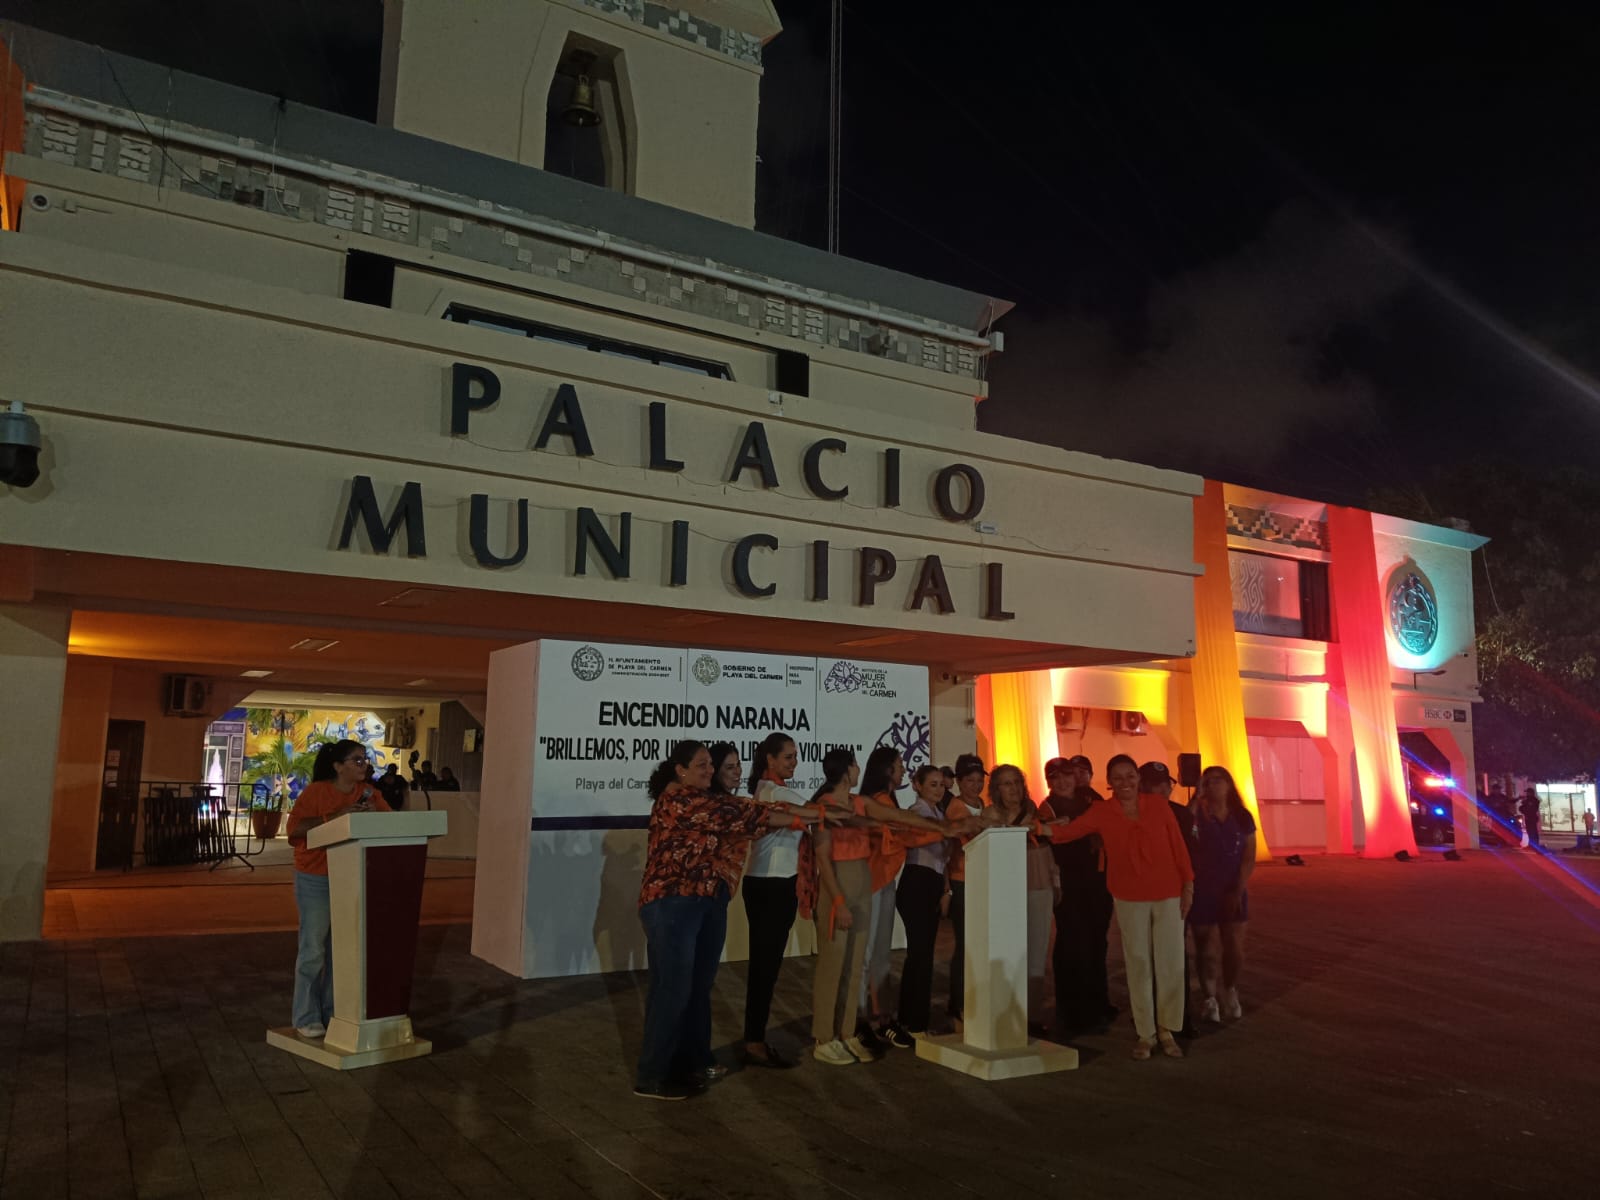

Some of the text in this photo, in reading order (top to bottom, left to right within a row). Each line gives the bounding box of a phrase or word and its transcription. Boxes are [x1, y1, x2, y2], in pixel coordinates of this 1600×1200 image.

[450, 362, 986, 522] PALACIO
[338, 474, 1016, 620] MUNICIPAL
[615, 657, 661, 665] AYUNTAMIENTO
[722, 665, 756, 673] GOBIERNO
[862, 673, 886, 681] MUJER
[862, 680, 887, 689] PLAYA
[869, 690, 897, 698] CARMEN
[599, 701, 810, 732] ENCENDIDO NARANJA
[539, 736, 629, 762] "BRILLEMOS,
[633, 739, 660, 761] POR
[575, 777, 606, 793] Playa
[609, 778, 624, 790] del
